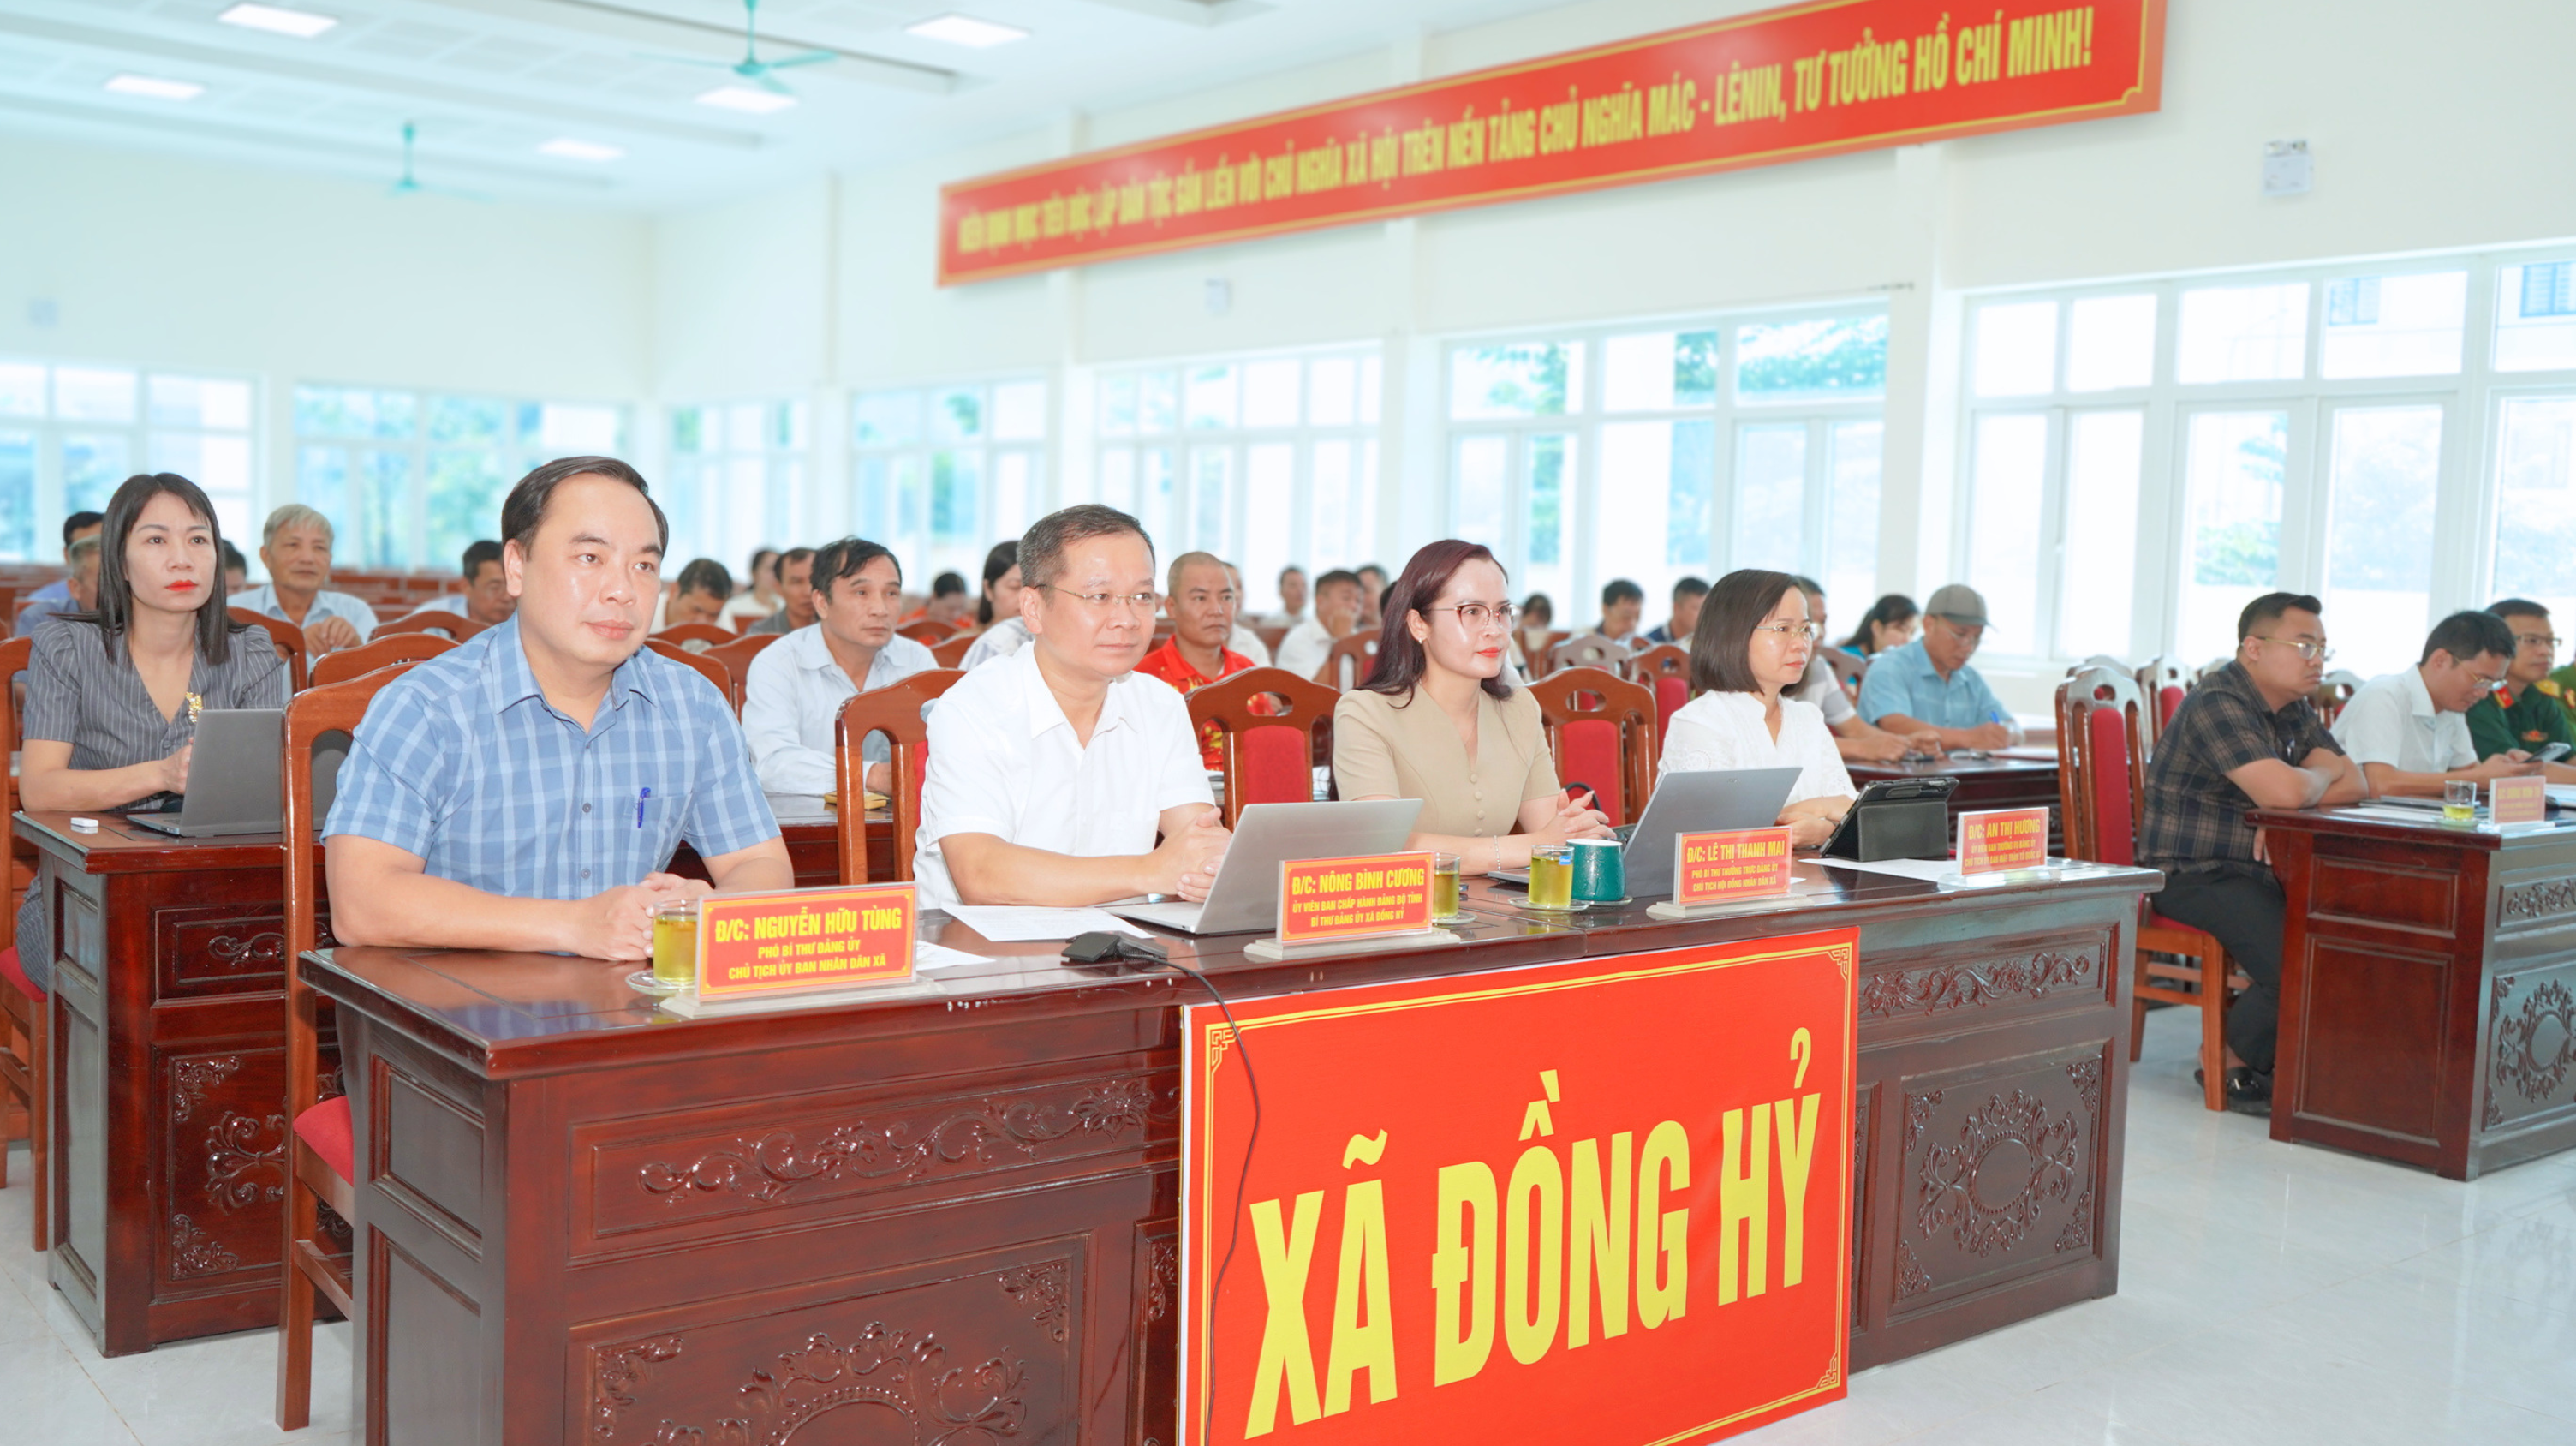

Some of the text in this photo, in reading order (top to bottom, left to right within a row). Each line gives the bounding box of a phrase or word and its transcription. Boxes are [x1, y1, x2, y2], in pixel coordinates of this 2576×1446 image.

[1403, 118, 1446, 176] TRÊN
[1488, 97, 1536, 163] TẢNG
[1540, 84, 1579, 155] CHỦ
[1582, 81, 1643, 148] NGHĨA
[1648, 71, 1696, 137] MÁC
[1715, 61, 1787, 126] LÊNIN,
[1794, 50, 1827, 112] TƯ
[1829, 27, 1908, 106] TƯỞNG
[1913, 12, 1950, 93] HỒ
[1956, 9, 2003, 86] CHÍ
[2007, 6, 2093, 78] MINH!
[1969, 824, 1985, 840] Đ/C:
[1987, 822, 1998, 838] AN
[2001, 822, 2012, 839] THỊ
[1687, 840, 1785, 863] Đ/C: LÊ THỊ THANH MAI
[1291, 875, 1315, 895] Đ/C:
[1319, 870, 1352, 893] NÔNG
[1356, 868, 1383, 890] BÌNH
[1292, 891, 1422, 913] ỦY VIÊN BAN CHẤP HÀNH ĐẢNG BỘ TỈNH
[715, 905, 902, 942] Đ/C: NGUYỄN HỮU TÙNG
[1311, 915, 1319, 927] BÍ
[1321, 915, 1334, 926] THƯ
[1334, 911, 1353, 924] ĐẢNG
[1355, 911, 1364, 923] ỦY
[758, 936, 861, 959] PHÓ BÍ THƯ ĐẢNG ỦY
[729, 953, 886, 980] CHỦ TỊCH ỦY BAN NHÂN DÂN XÃ
[1244, 1026, 1821, 1440] XÃ ĐỒNG HỶ
